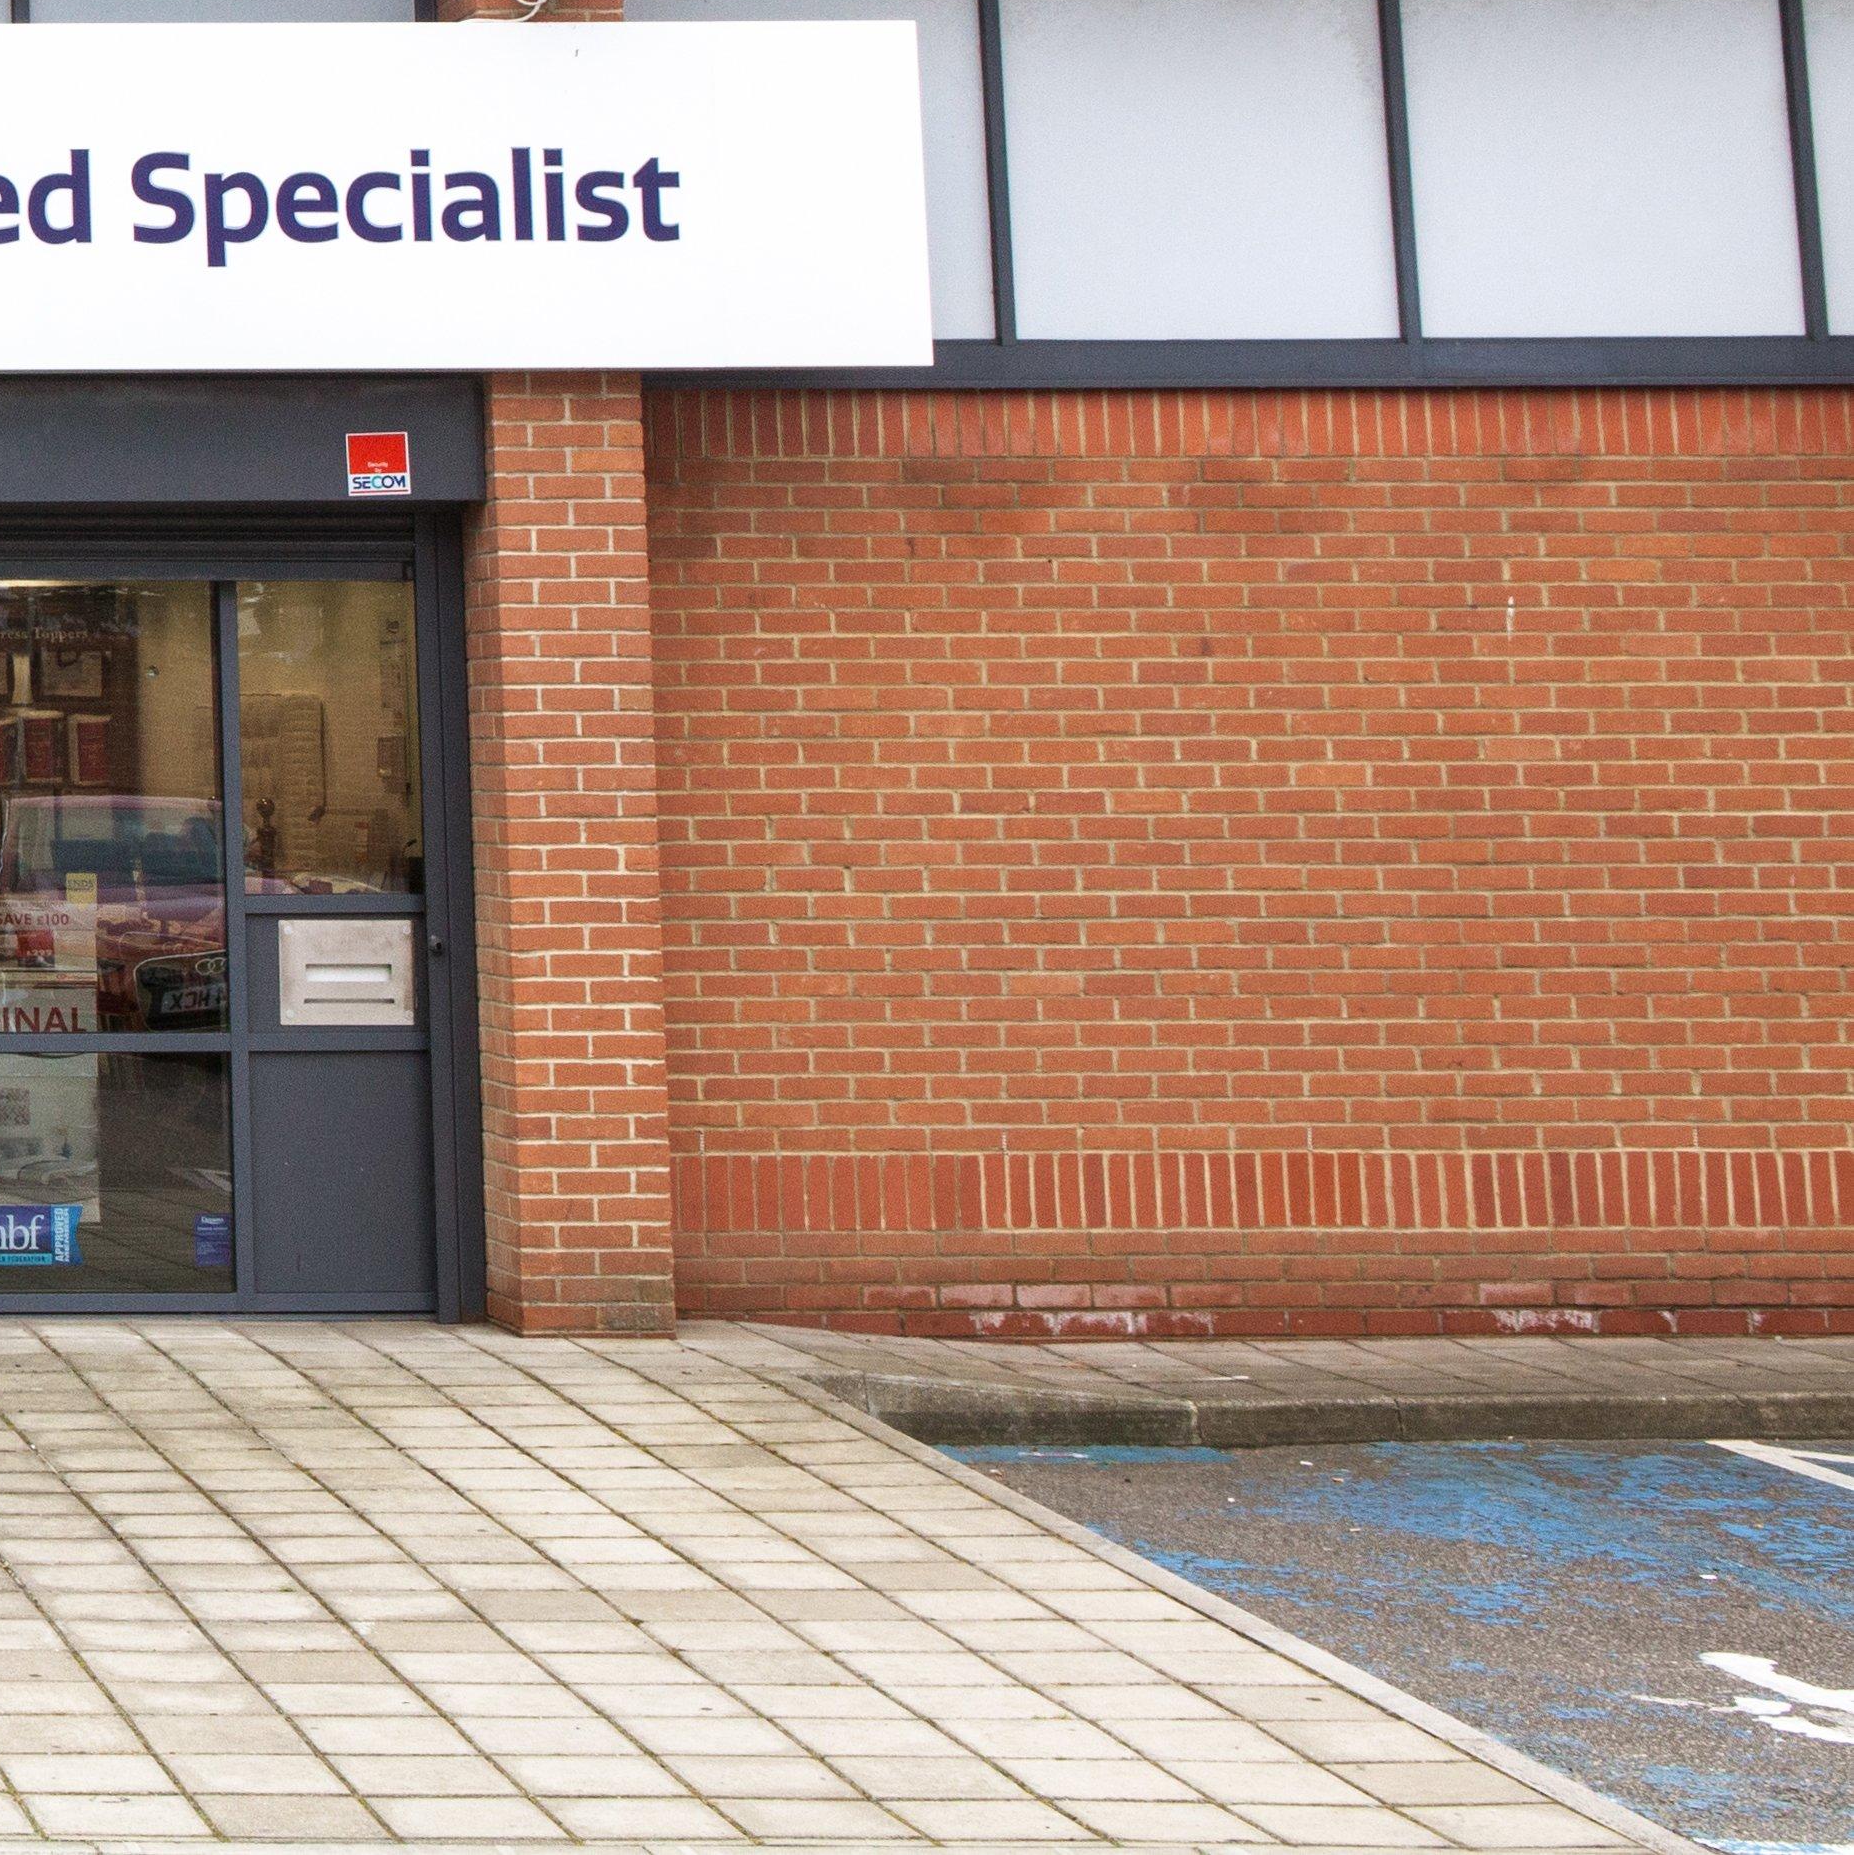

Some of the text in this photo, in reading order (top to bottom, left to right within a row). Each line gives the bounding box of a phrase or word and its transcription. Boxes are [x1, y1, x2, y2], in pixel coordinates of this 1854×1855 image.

[132, 146, 680, 267] Specialist
[352, 475, 406, 490] SECOM
[34, 627, 89, 643] Toppers
[37, 913, 70, 926] £100
[53, 1207, 64, 1263] APPROVED
